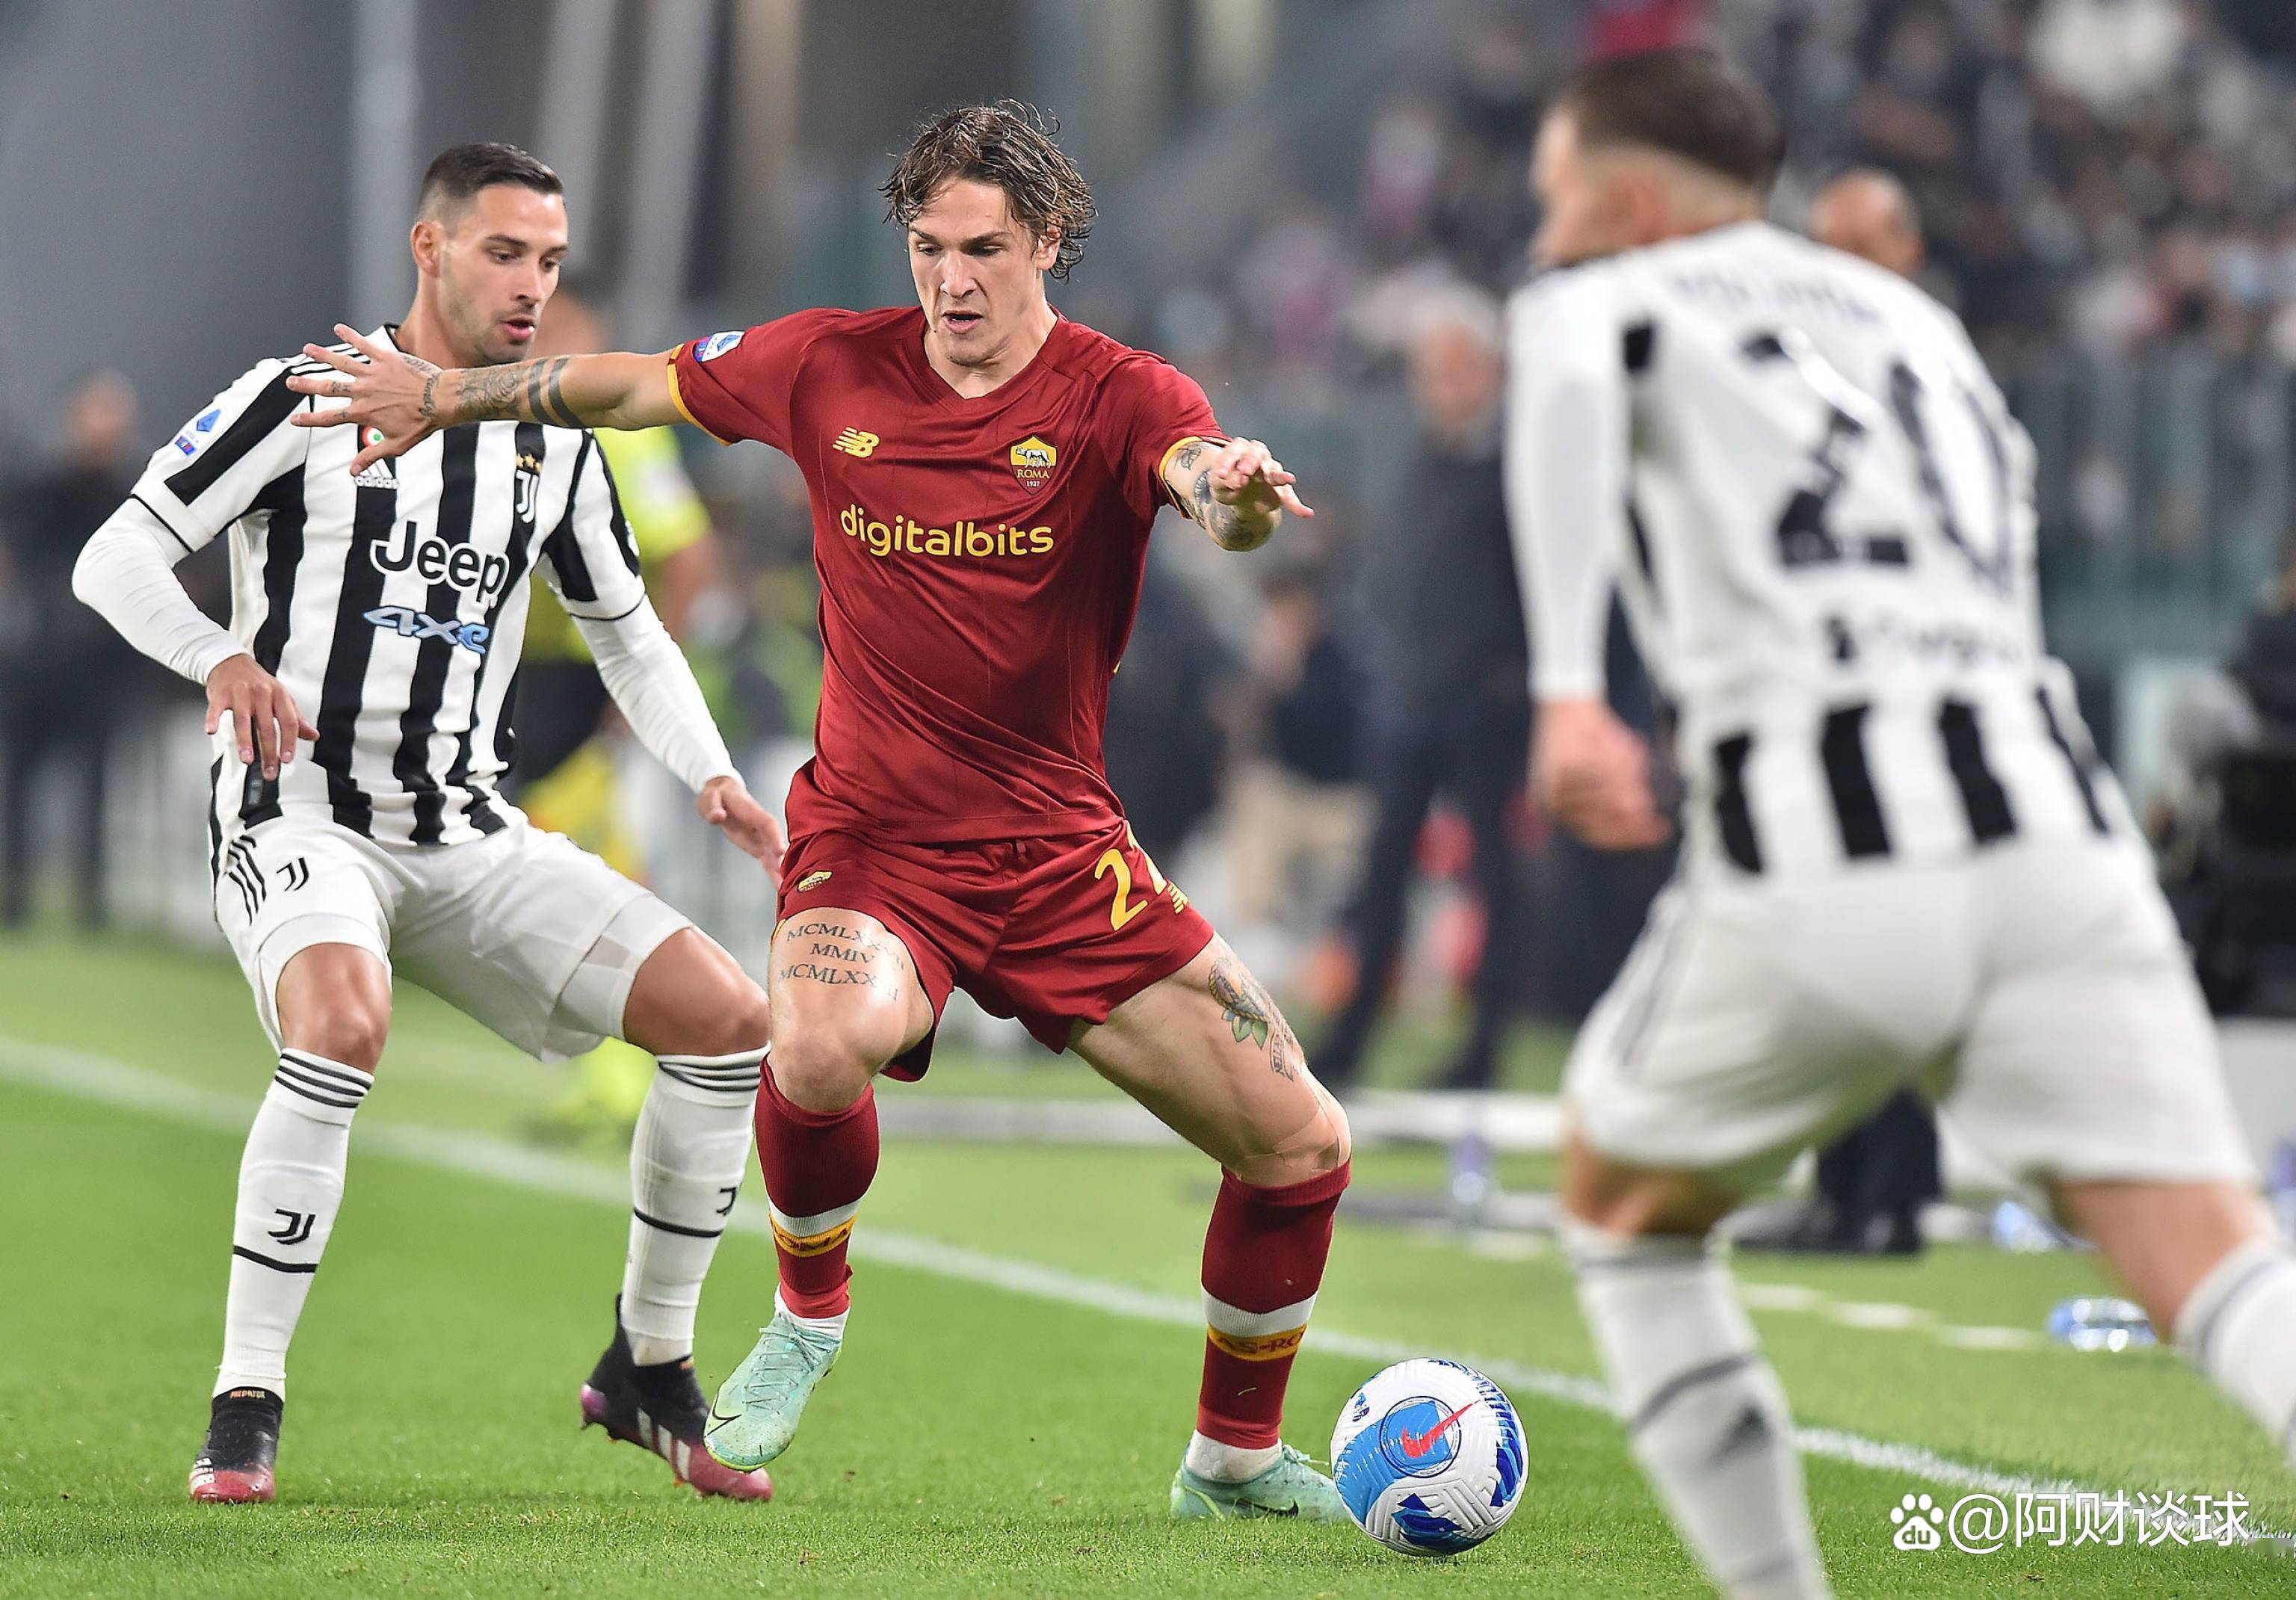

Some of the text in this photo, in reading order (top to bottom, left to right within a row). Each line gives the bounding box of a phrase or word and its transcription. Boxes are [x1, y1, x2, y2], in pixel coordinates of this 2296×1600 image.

[1017, 469, 1050, 478] ROMA
[840, 504, 1055, 557] digitalbits
[375, 521, 505, 603] Jeep
[810, 943, 875, 963] MMIV
